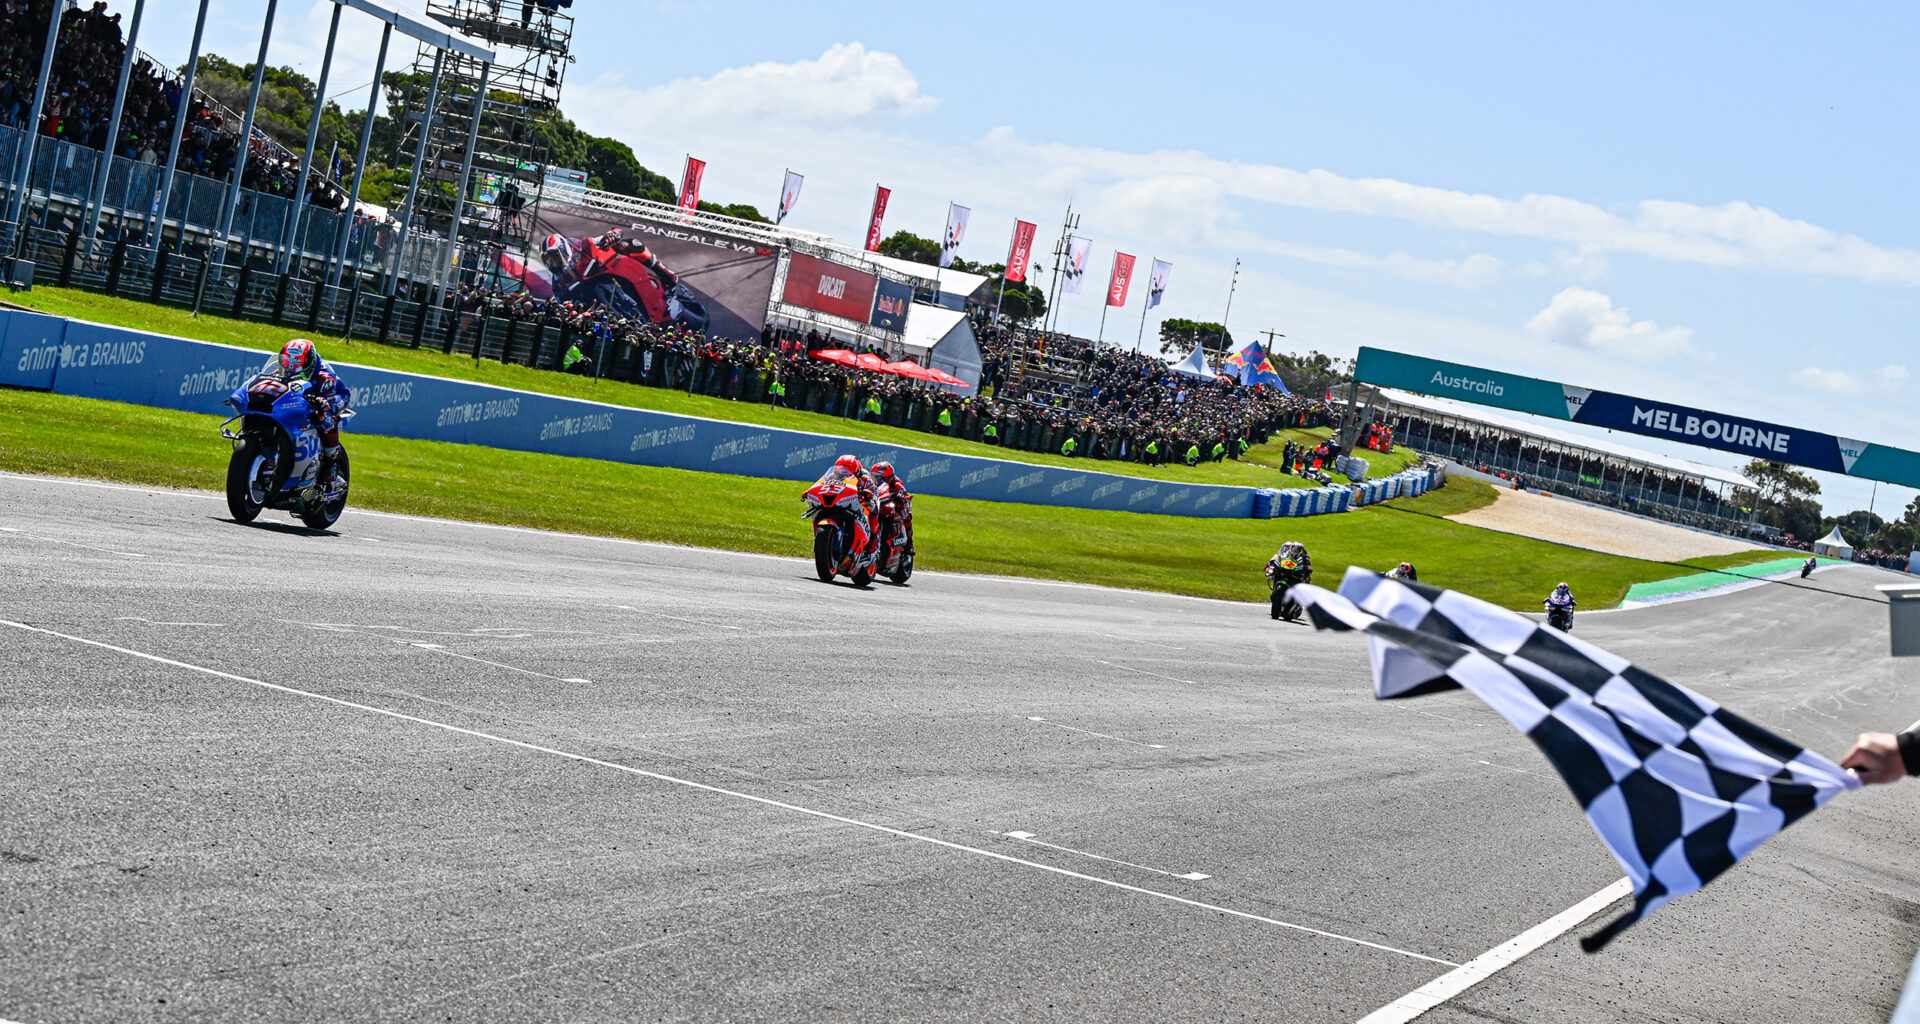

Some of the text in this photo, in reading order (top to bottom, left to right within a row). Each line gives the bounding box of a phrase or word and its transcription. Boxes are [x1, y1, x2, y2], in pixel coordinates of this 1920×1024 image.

[631, 222, 730, 249] PANIGALE
[817, 274, 846, 299] DUCATI
[1112, 258, 1131, 302] AUSGP
[18, 338, 146, 372] animoca BRANDS
[179, 365, 241, 396] animoca
[248, 379, 288, 397] 42
[371, 381, 413, 405] BRANDS
[1430, 370, 1504, 397] Australia
[437, 397, 520, 427] animoca BRANDS
[1564, 395, 1585, 405] MEL
[581, 412, 614, 433] BRANDS
[667, 423, 696, 446] BRANDS
[1632, 405, 1790, 454] MELBOURNE
[1840, 447, 1860, 459] MEL
[818, 484, 846, 495] 93
